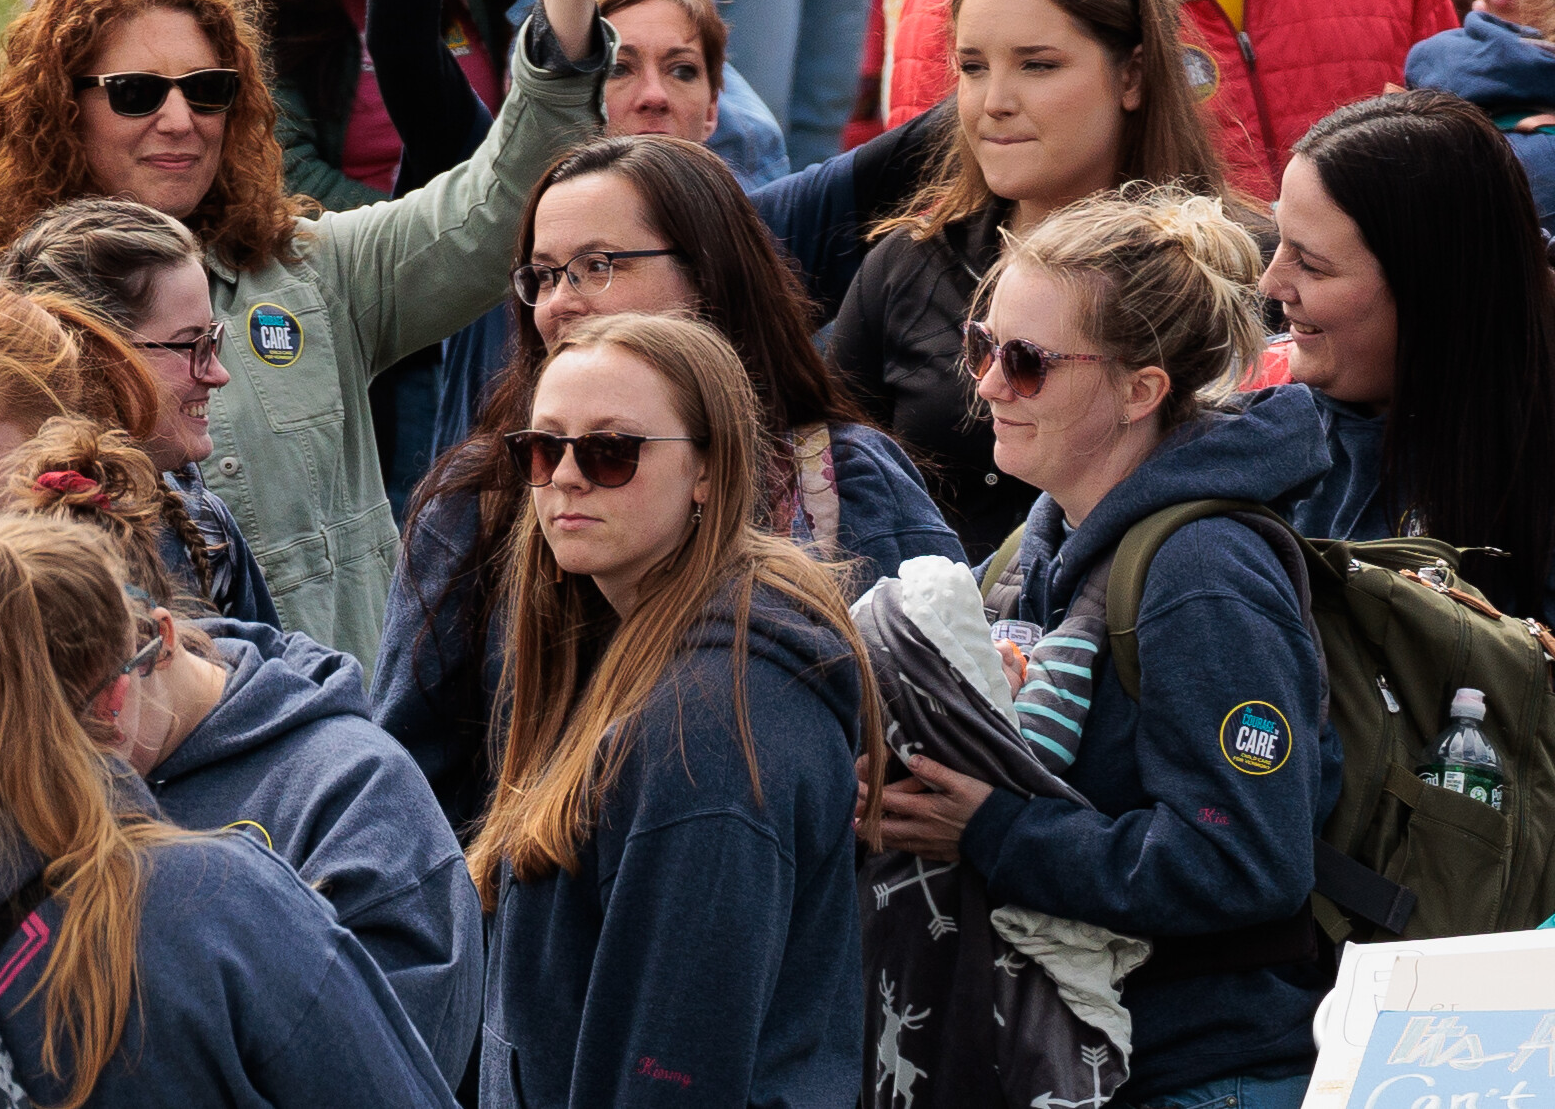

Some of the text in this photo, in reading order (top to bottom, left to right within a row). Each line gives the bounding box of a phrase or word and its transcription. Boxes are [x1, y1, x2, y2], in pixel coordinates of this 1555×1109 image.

[260, 326, 293, 349] CARE
[1242, 714, 1277, 733] COURAGE
[1236, 726, 1279, 760] CARE
